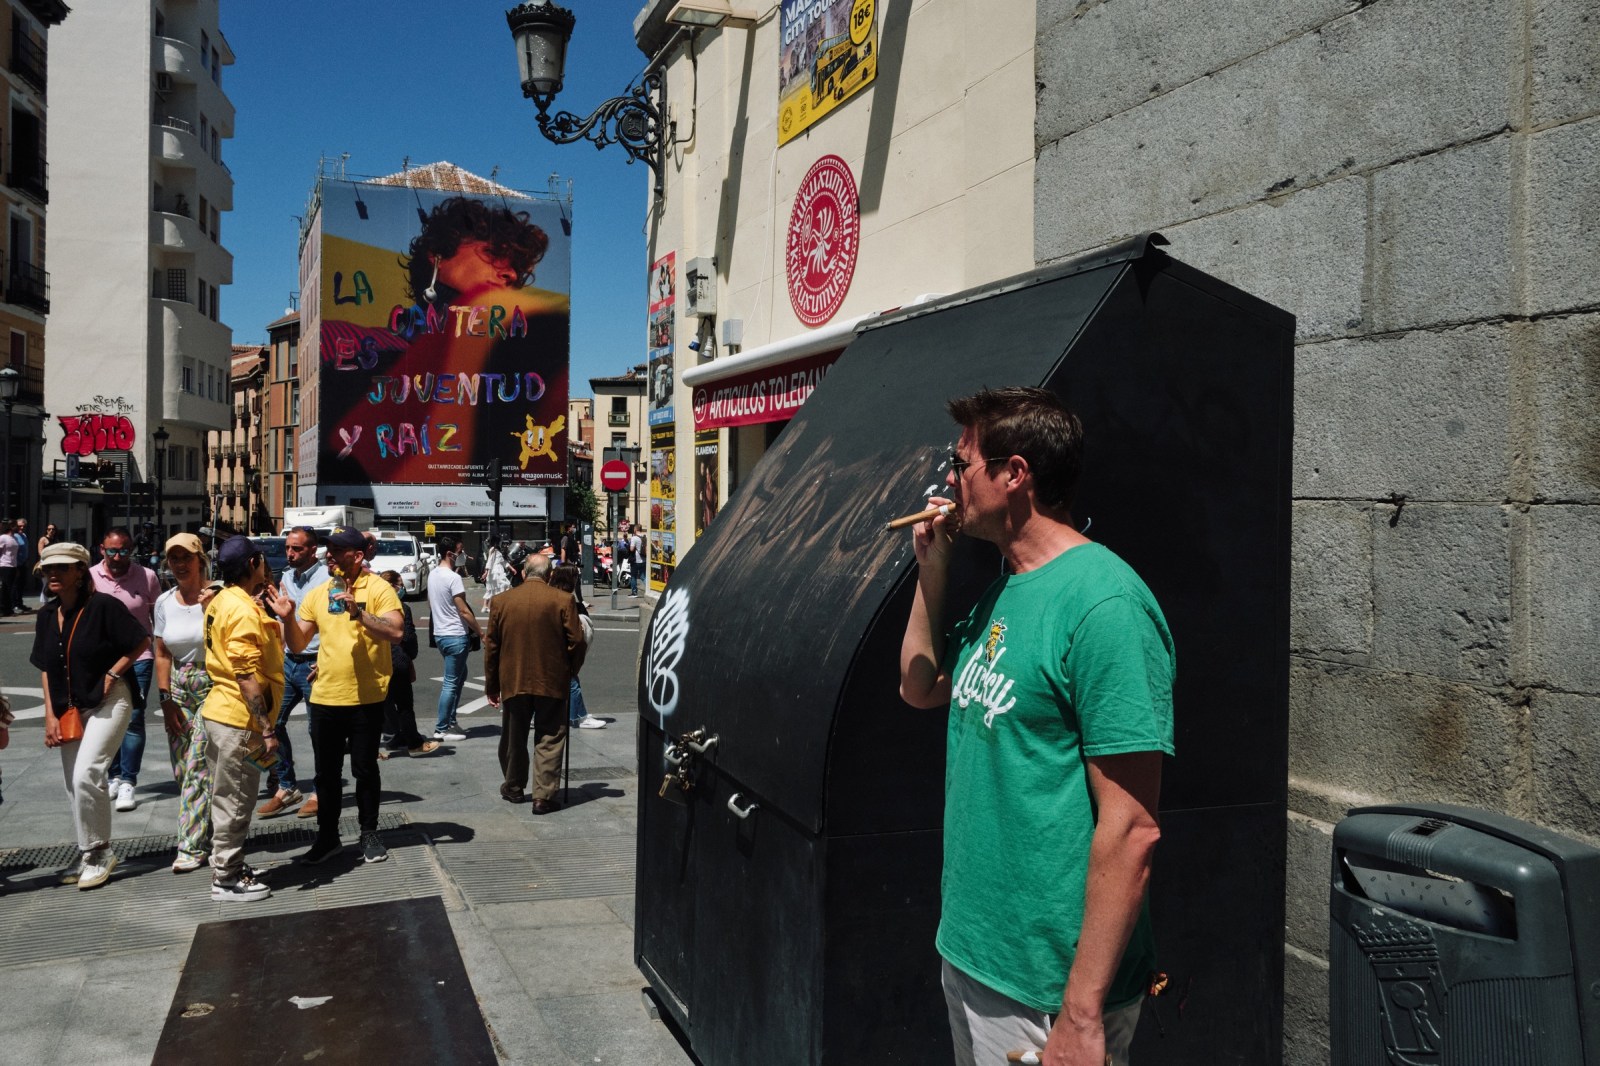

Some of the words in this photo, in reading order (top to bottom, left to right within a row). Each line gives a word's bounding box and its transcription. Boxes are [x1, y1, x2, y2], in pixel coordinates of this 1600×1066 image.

[785, 14, 806, 45] CITY
[853, 4, 871, 30] 18€
[334, 270, 374, 306] LA
[387, 303, 528, 341] CANTERA
[335, 335, 379, 371] ES
[367, 371, 546, 406] JUVENTUD
[709, 380, 766, 420] ARTICULOS
[694, 397, 706, 416] 47
[337, 425, 363, 460] Y
[376, 416, 463, 459] RAÍZ
[695, 445, 718, 456] FLAMENCO
[584, 524, 590, 532] P
